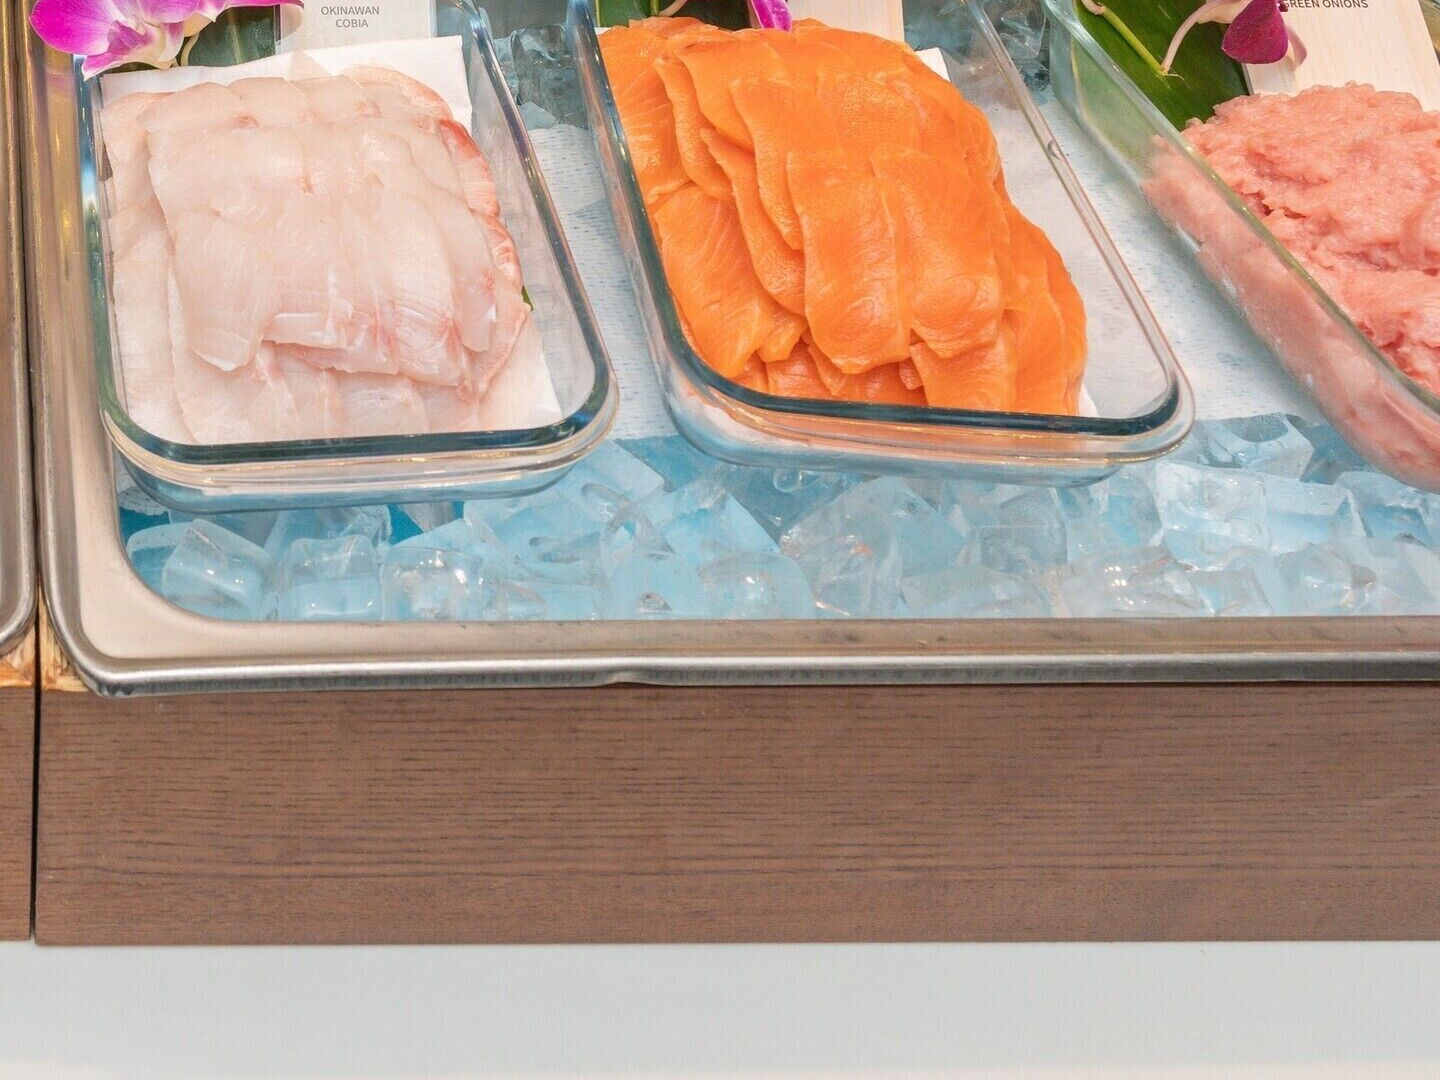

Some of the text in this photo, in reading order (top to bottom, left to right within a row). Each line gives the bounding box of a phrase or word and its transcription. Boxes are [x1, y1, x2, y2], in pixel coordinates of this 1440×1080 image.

[1323, 0, 1369, 9] ONIONS
[321, 5, 380, 16] OKINAWAN
[335, 18, 369, 28] COBIA
